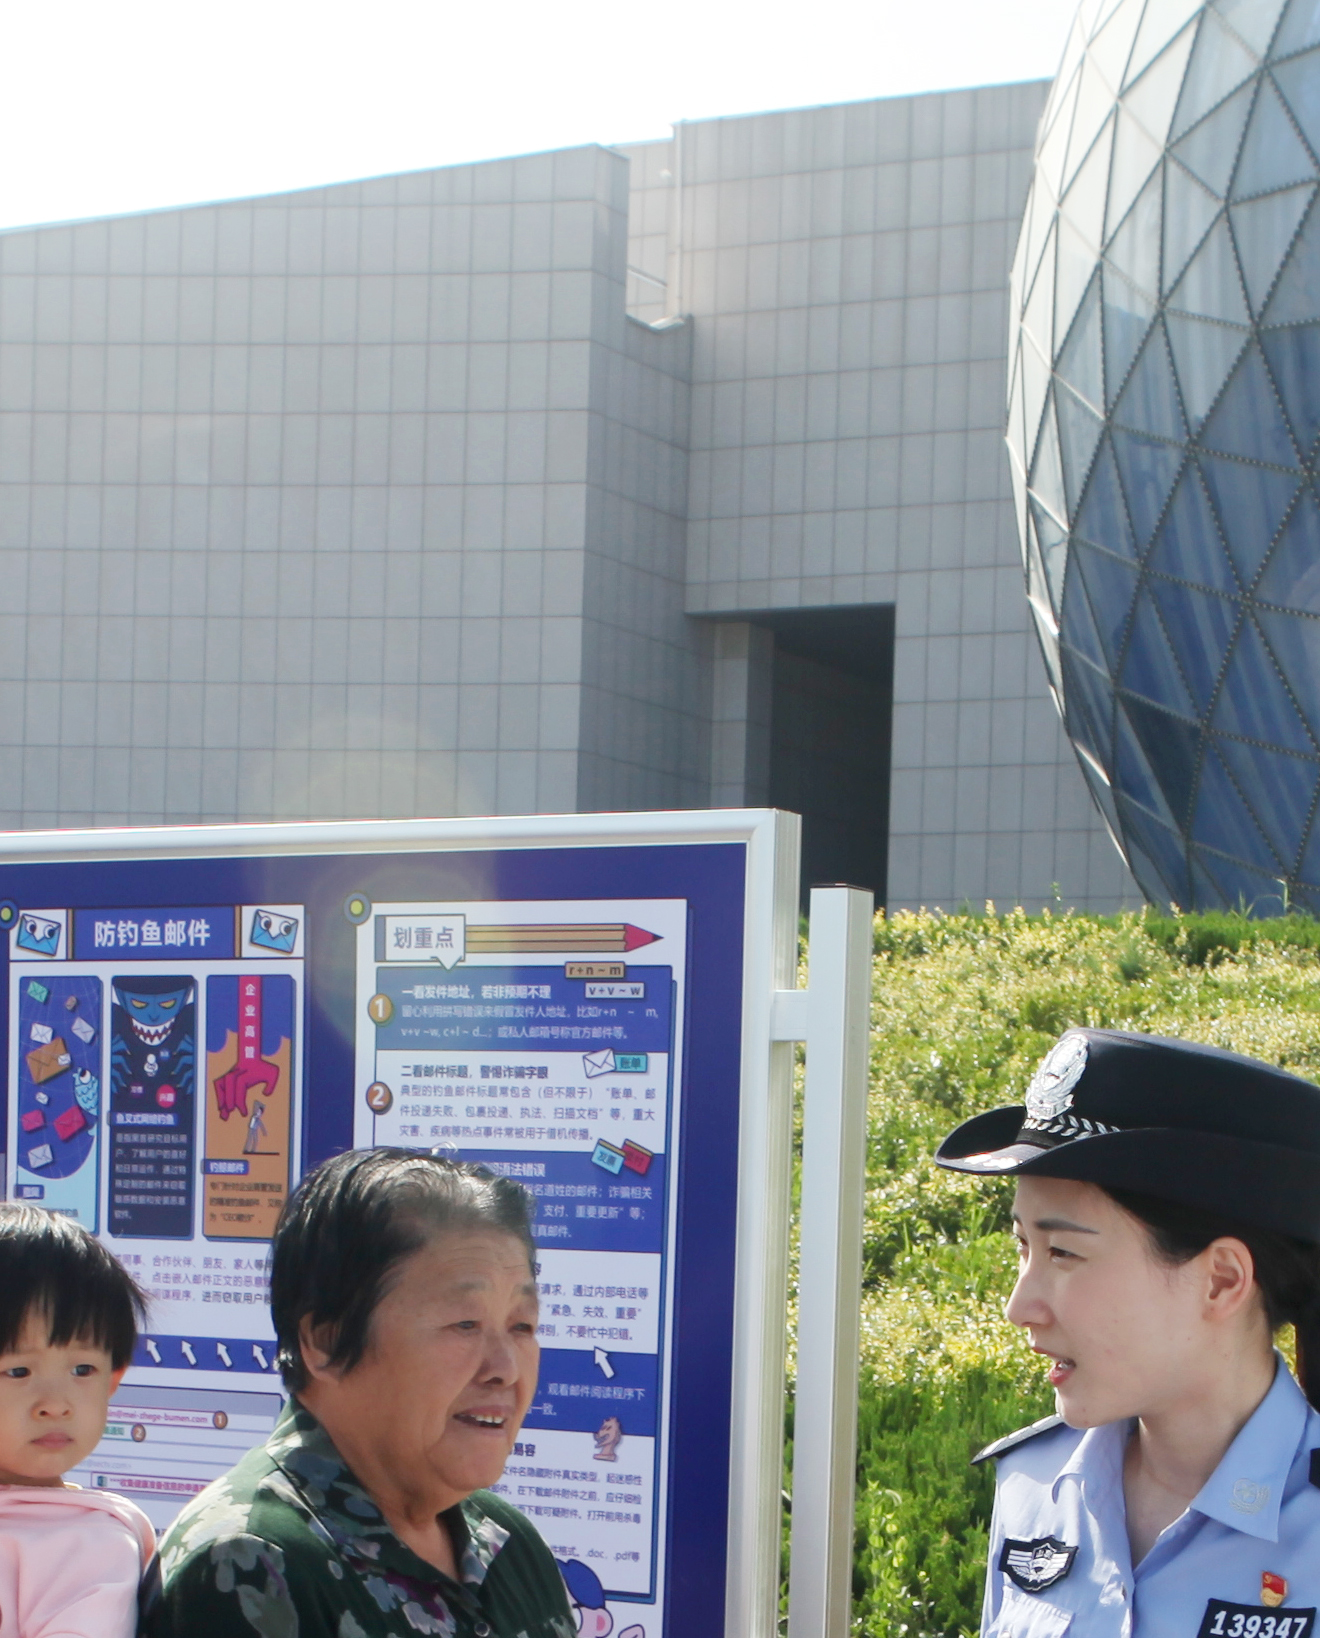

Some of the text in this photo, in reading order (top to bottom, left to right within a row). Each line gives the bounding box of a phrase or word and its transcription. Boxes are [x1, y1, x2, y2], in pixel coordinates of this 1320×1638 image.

[94, 920, 211, 948] 防钓鱼邮件
[393, 926, 454, 949] 划重点
[375, 999, 384, 1018] 1
[372, 1086, 384, 1105] 2
